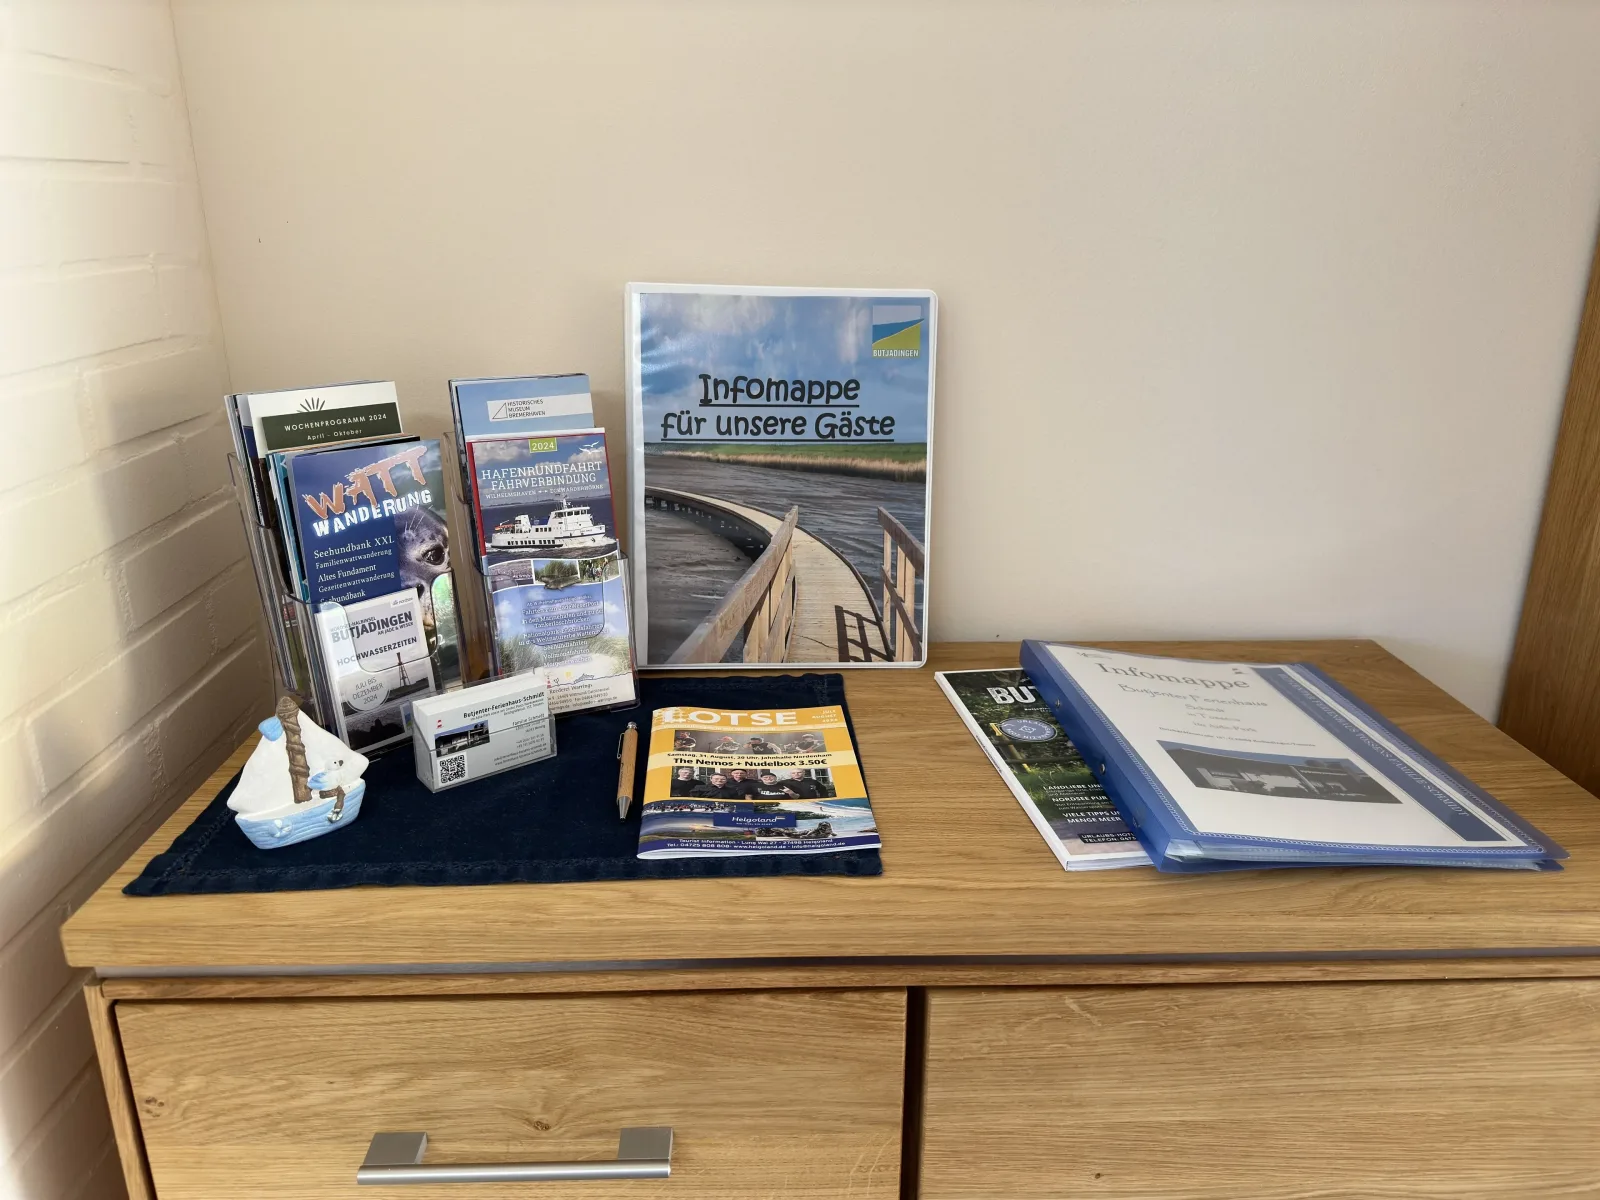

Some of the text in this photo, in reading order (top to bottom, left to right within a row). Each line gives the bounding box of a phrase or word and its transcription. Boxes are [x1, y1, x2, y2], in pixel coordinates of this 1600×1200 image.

[872, 348, 919, 358] BUTJADINGEN
[698, 374, 860, 404] Infomappe
[507, 398, 544, 407] HISTORISCHES
[284, 414, 387, 432] WOCHENPROGRAMM 2024
[508, 410, 546, 419] BREMERHAVEN
[661, 410, 895, 438] für unsere Gäste
[307, 432, 325, 441] April
[334, 428, 362, 437] Oktober
[532, 442, 554, 451] 2024
[481, 460, 602, 480] HAFENRUNDFAHRT
[302, 445, 428, 519] WATT
[490, 472, 597, 491] FÄHRVERBINDUNG
[486, 489, 536, 500] WILHELMSHAVEN
[312, 489, 432, 537] WANDERUNG
[314, 535, 395, 559] Seehundbank XXL
[316, 548, 392, 570] Familienwattwanderung
[318, 564, 376, 583] Altes Fundament
[318, 571, 395, 593] Gezeitenwattwanderung
[331, 610, 413, 643] BUTJADINGEN
[336, 636, 418, 666] HOCHWASSERZEITEN
[1095, 662, 1250, 690] Infomappe
[352, 682, 384, 700] DEZEMBER
[662, 709, 798, 726] LOTSE
[698, 759, 734, 767] Nemos
[744, 760, 796, 768] Nudelbox
[1422, 785, 1470, 816] SCHMIDT
[732, 816, 777, 824] Helgoland
